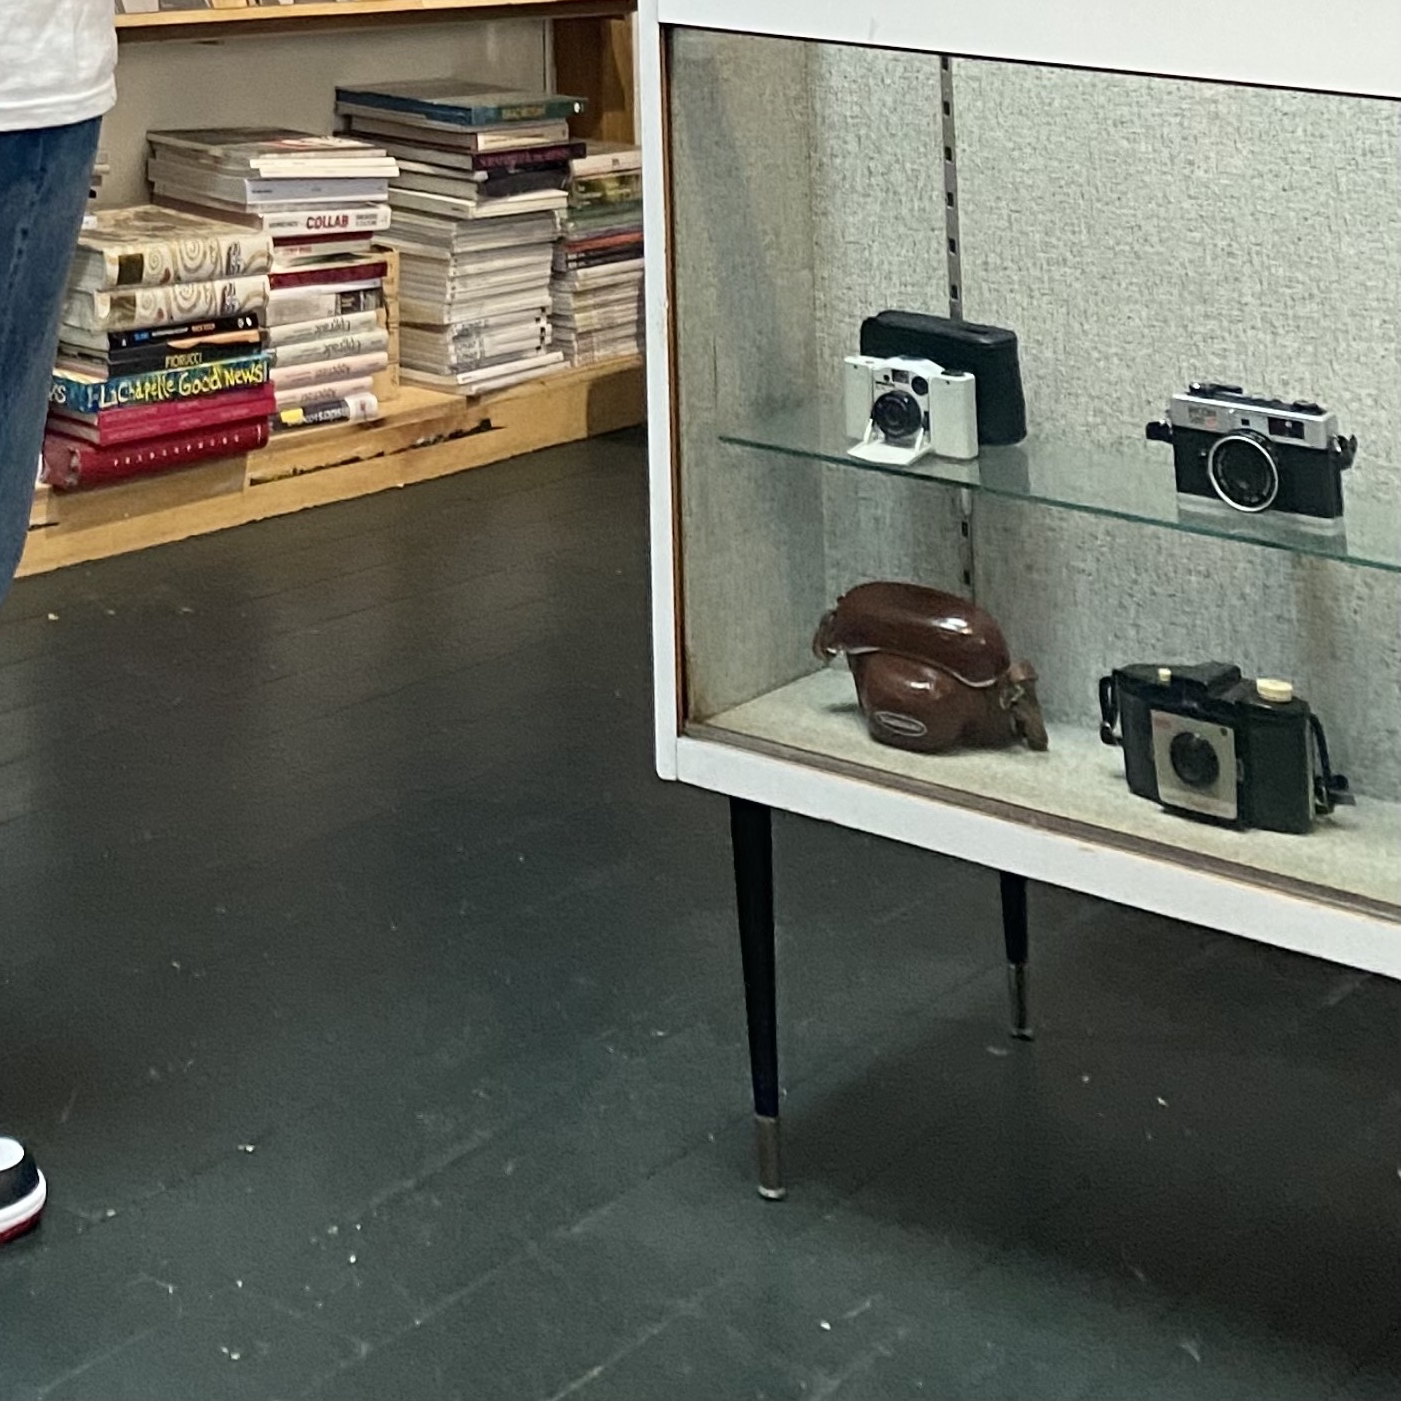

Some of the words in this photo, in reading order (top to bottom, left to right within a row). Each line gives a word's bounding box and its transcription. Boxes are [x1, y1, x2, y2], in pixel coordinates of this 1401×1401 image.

[306, 215, 349, 230] COLLAB
[165, 352, 203, 369] FIORUCCI
[178, 365, 221, 395] Good
